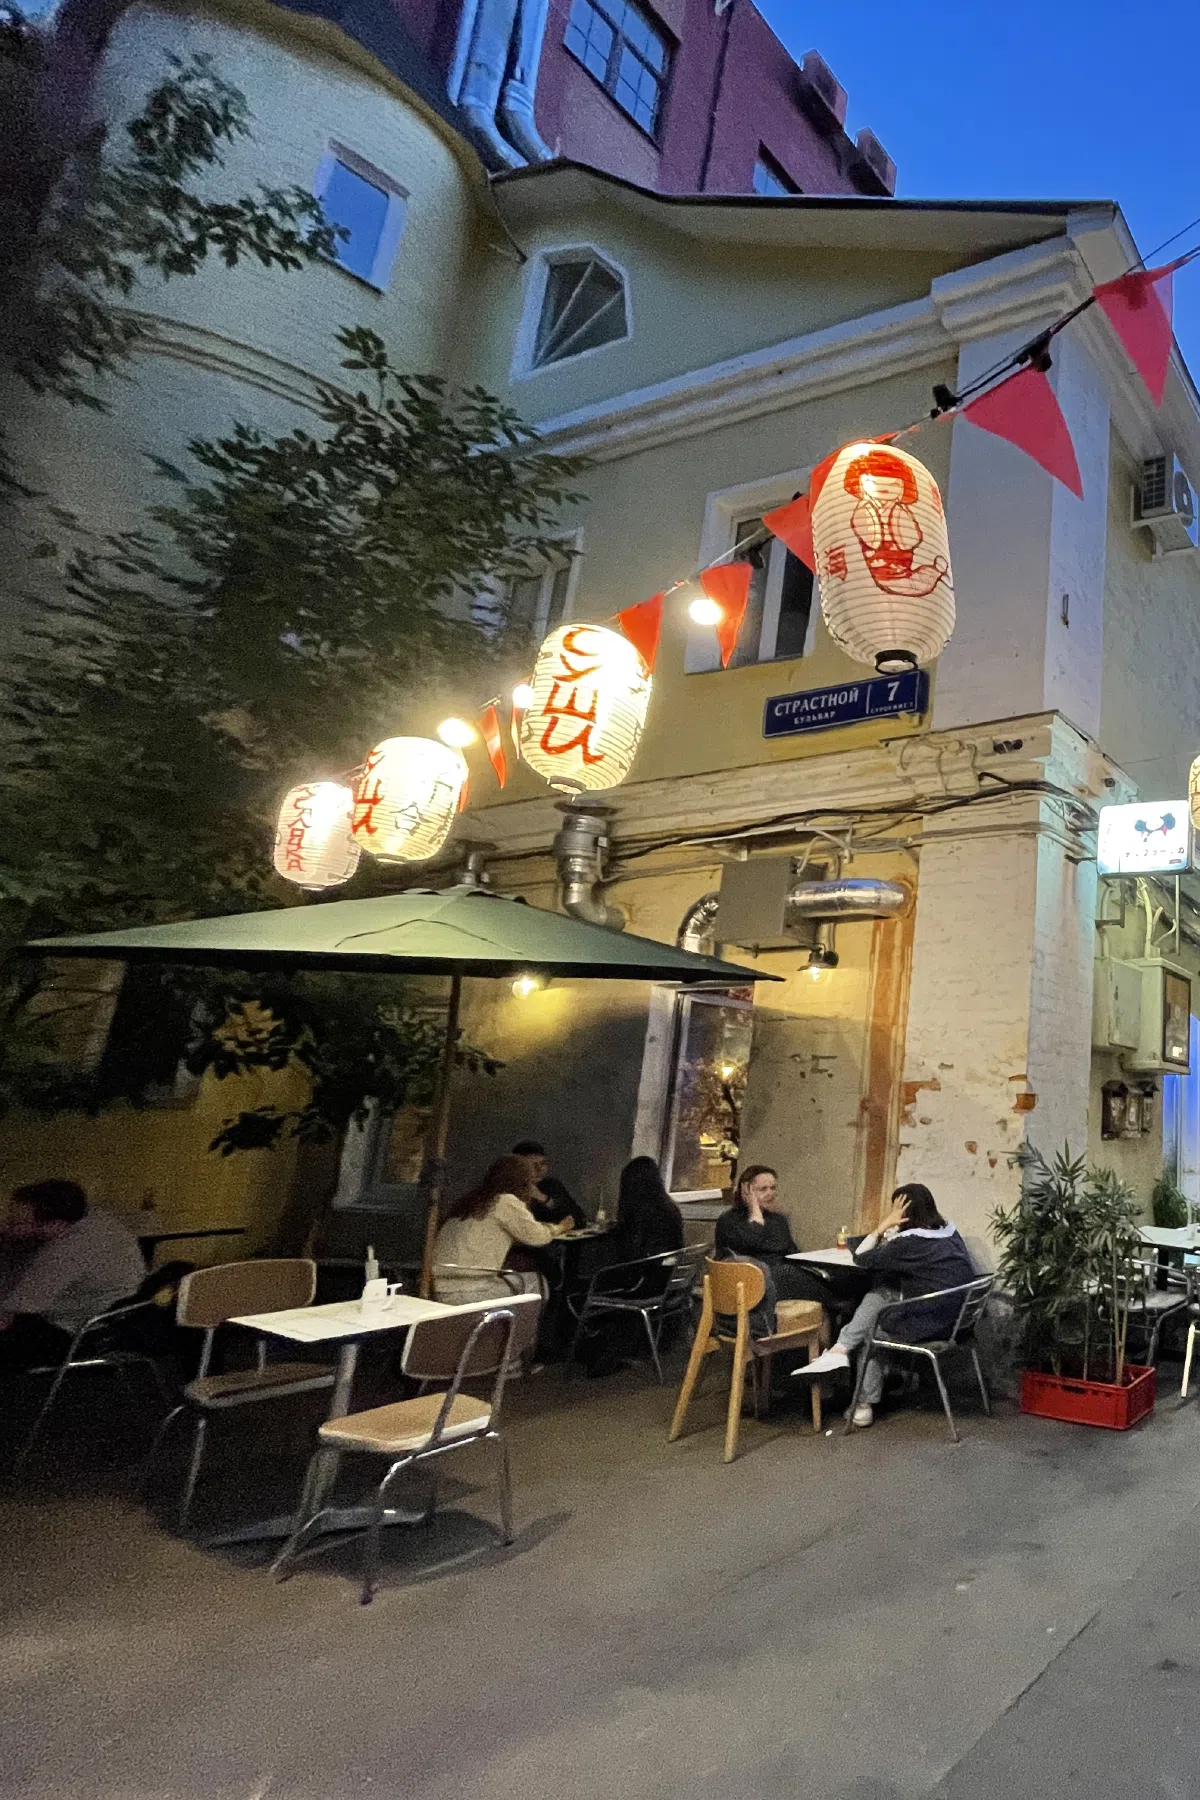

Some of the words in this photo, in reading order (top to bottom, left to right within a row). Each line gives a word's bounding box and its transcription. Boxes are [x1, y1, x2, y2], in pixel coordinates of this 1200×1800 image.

[774, 687, 859, 716] СТРАСТНОЙ
[887, 681, 900, 702] 7
[794, 711, 836, 725] БУЛЬВАР
